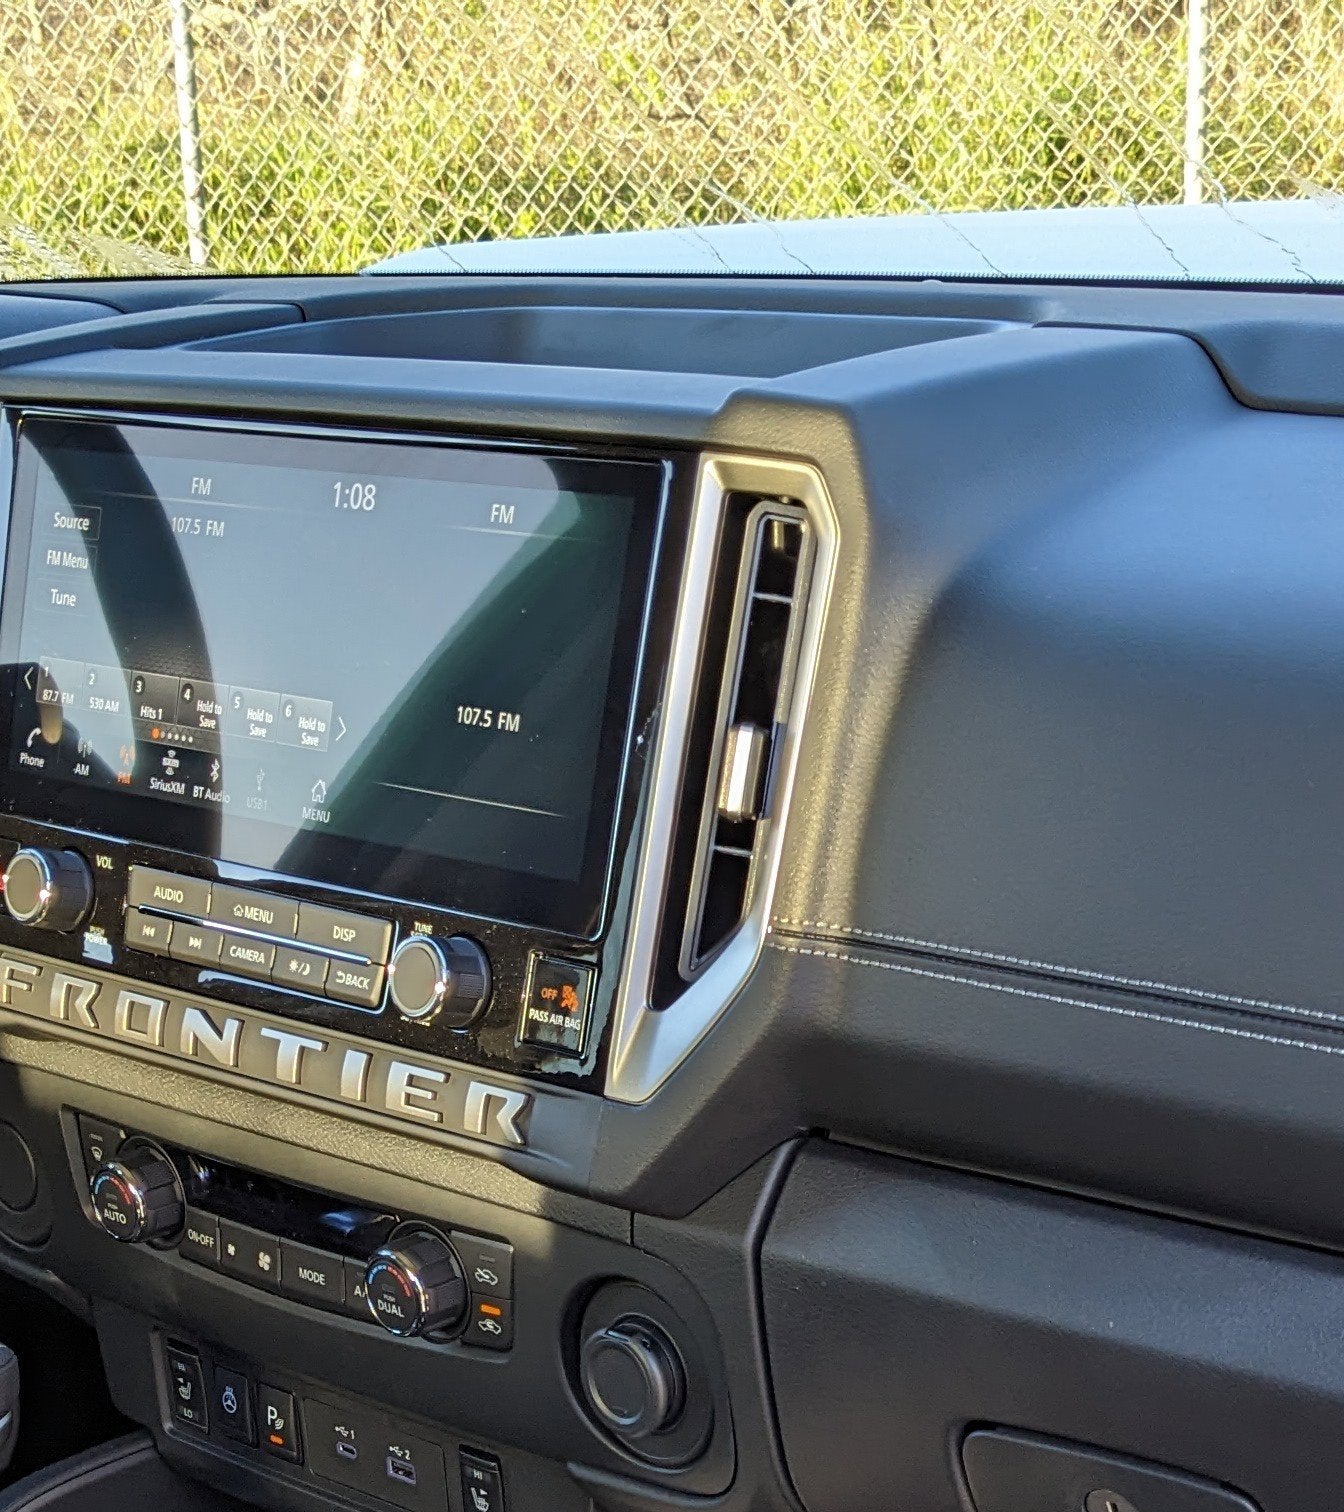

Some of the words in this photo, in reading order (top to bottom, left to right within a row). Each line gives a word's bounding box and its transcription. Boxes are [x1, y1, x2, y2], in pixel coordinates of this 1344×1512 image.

[191, 477, 212, 496] FM
[333, 481, 377, 511] 1:08
[53, 512, 90, 531] Source
[490, 503, 515, 524] FM
[171, 517, 201, 536] 107.5
[205, 519, 225, 538] FM
[46, 549, 61, 566] FM
[62, 551, 89, 570] Menu
[50, 589, 77, 607] Tune
[88, 674, 95, 685] 2
[135, 681, 142, 693] 3
[60, 692, 74, 705] FM
[183, 688, 191, 700] 4
[88, 696, 104, 710] 530
[105, 699, 120, 713] AM
[196, 700, 213, 714] Hold
[214, 703, 223, 715] to
[233, 696, 241, 709] 5
[140, 705, 156, 719] Hits
[157, 708, 163, 720] 1
[246, 708, 263, 722] Hold
[264, 711, 274, 724] to
[285, 705, 292, 718] 6
[457, 705, 492, 728] 107.5
[497, 711, 521, 733] FM
[199, 715, 216, 729] Save
[298, 716, 316, 731] Hold
[316, 719, 326, 732] to
[249, 724, 267, 738] Save
[301, 732, 319, 747] Save
[19, 752, 45, 768] Phone
[74, 763, 90, 776] AM
[149, 777, 186, 795] SiriusXM
[192, 785, 204, 798] BT
[204, 786, 231, 804] Audio
[302, 807, 331, 823] MENU
[96, 854, 114, 870] VOL
[153, 885, 184, 903] AUDIO
[244, 906, 274, 925] MENU
[333, 925, 356, 942] DISP
[414, 921, 433, 934] TUNE
[229, 945, 265, 964] CAMERA
[345, 973, 370, 990] BACK
[540, 987, 558, 1000] OFF
[528, 1008, 549, 1023] PASS
[549, 1014, 564, 1026] AIR
[563, 1016, 581, 1031] BAG
[104, 1208, 127, 1225] AUTO
[187, 1228, 215, 1248] ON-OFF
[298, 1266, 326, 1286] MODE
[377, 1298, 405, 1318] DUAL
[404, 1450, 411, 1461] 2
[473, 1468, 483, 1480] HI
